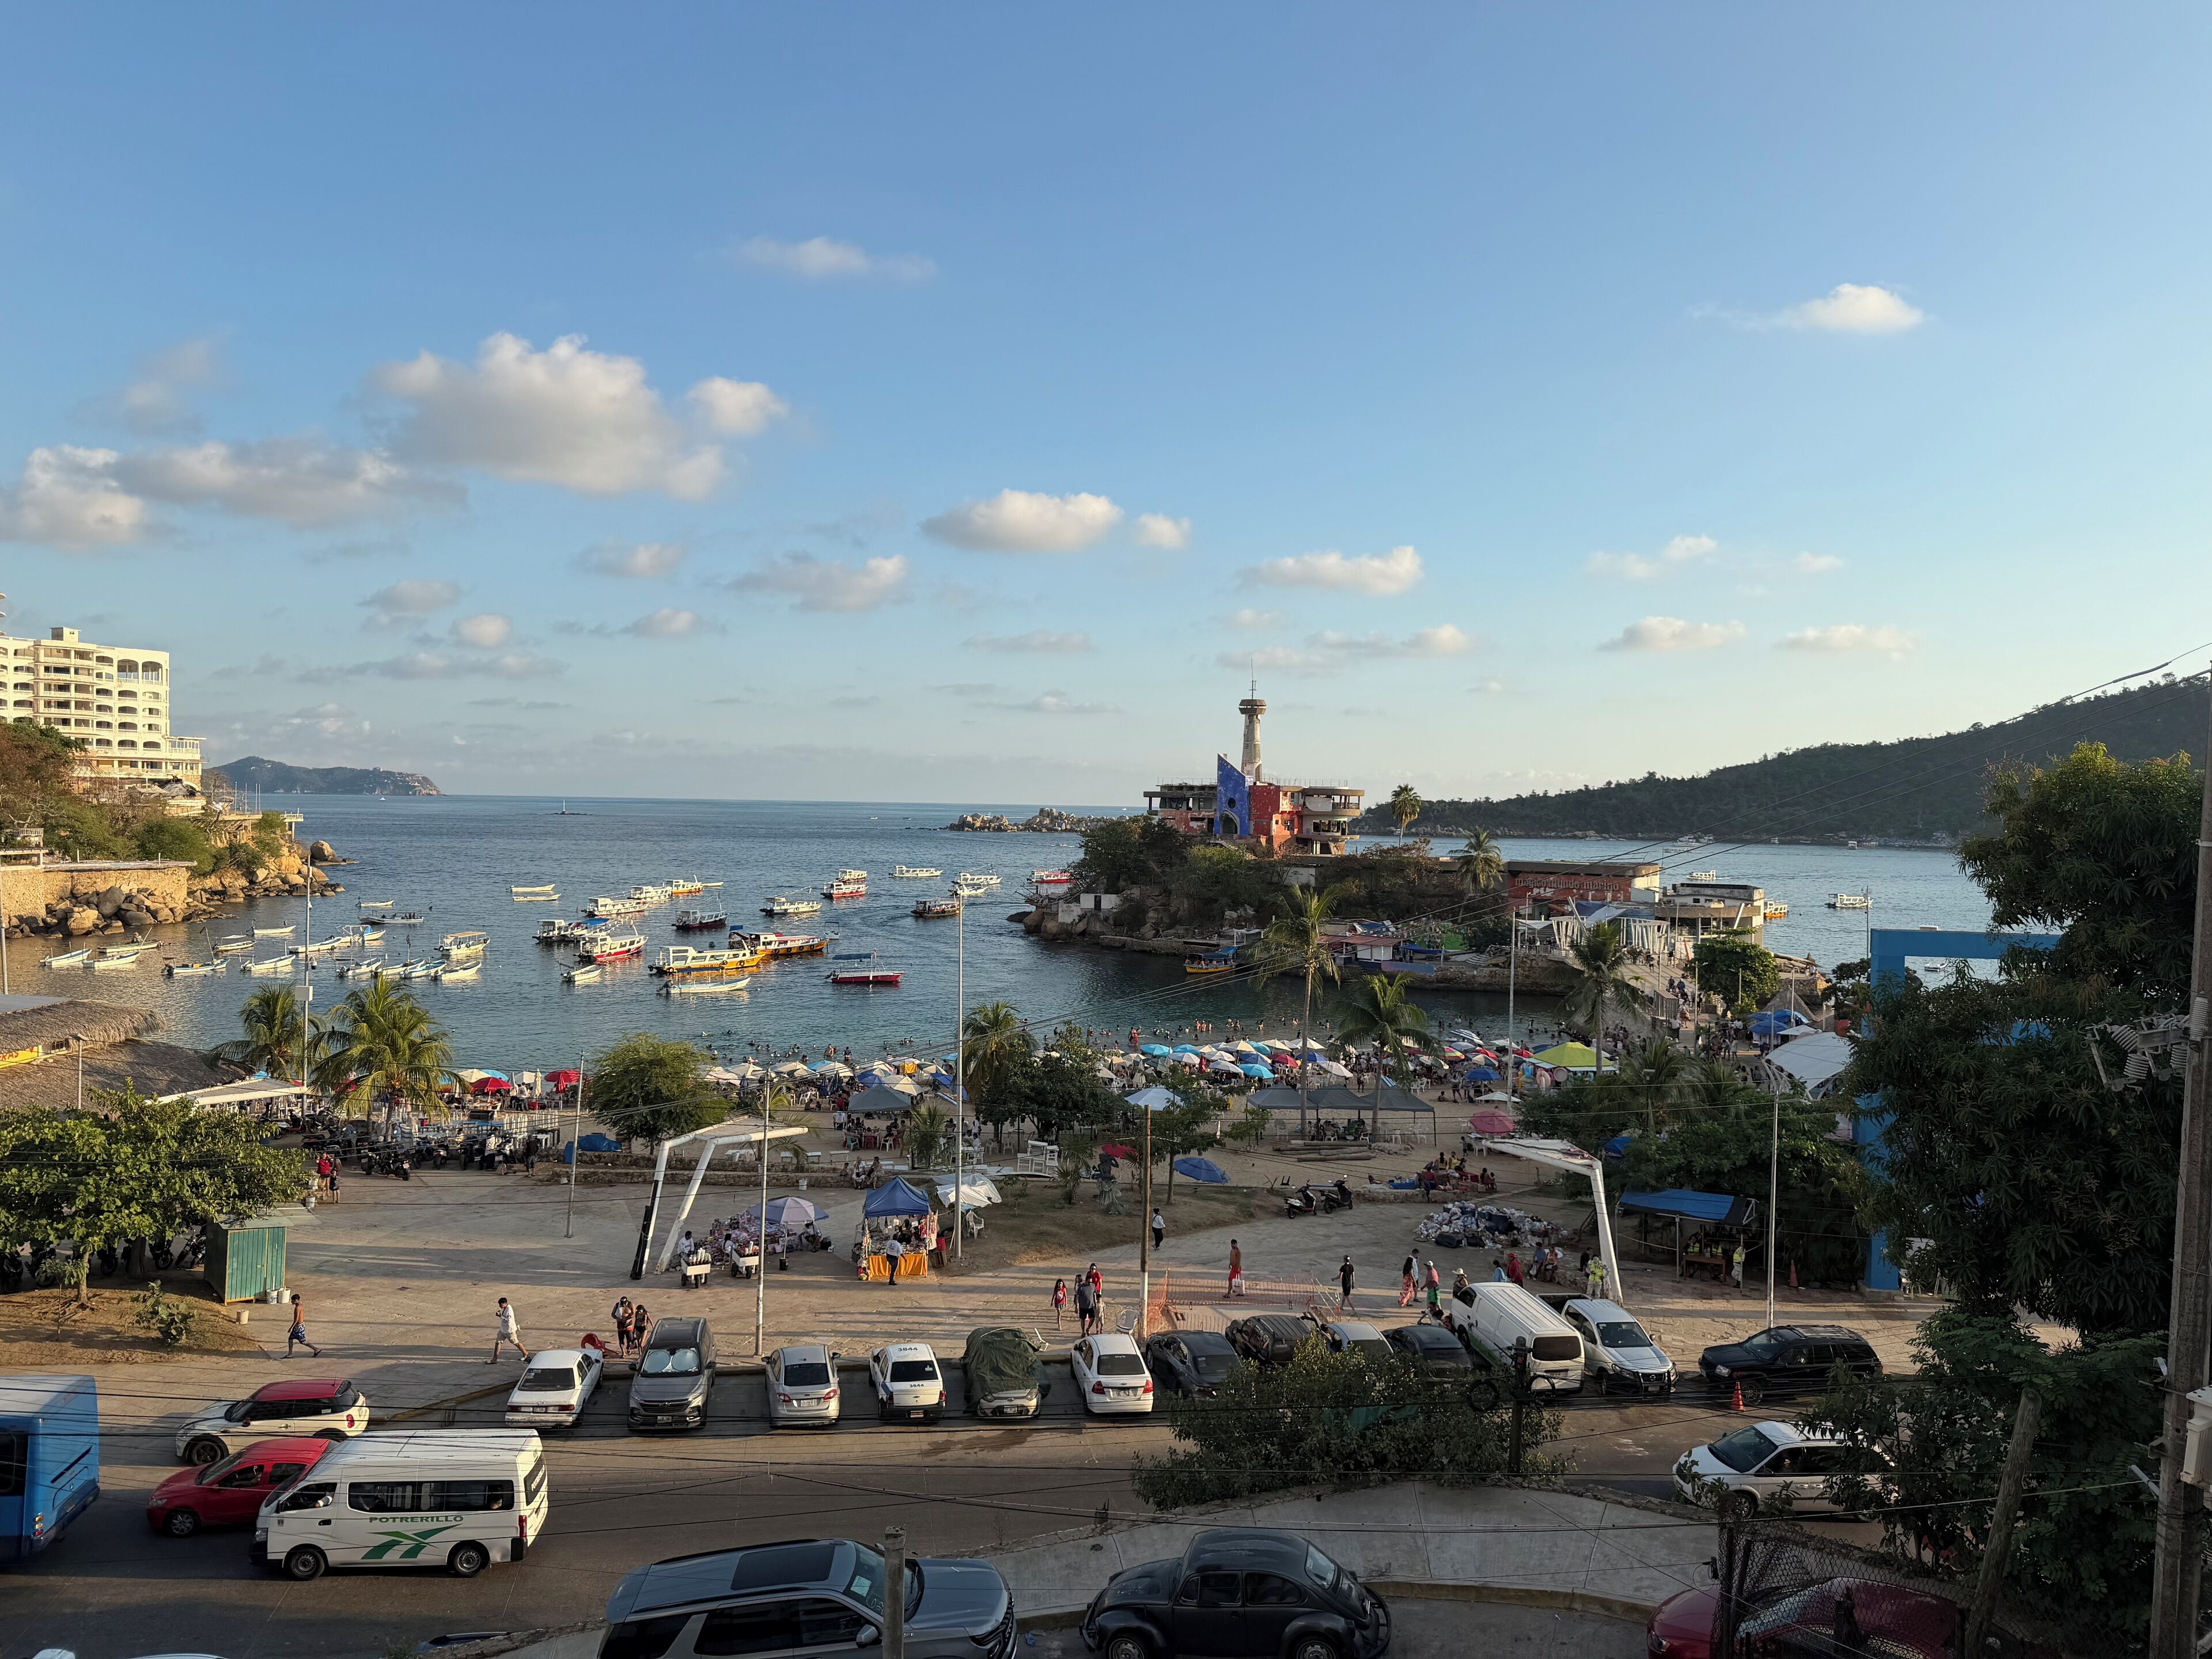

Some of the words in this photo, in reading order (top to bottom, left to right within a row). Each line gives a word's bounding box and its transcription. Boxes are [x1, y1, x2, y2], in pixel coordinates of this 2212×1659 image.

[1515, 876, 1547, 888] mágico
[1548, 878, 1580, 889] mundo
[1584, 880, 1619, 891] marino
